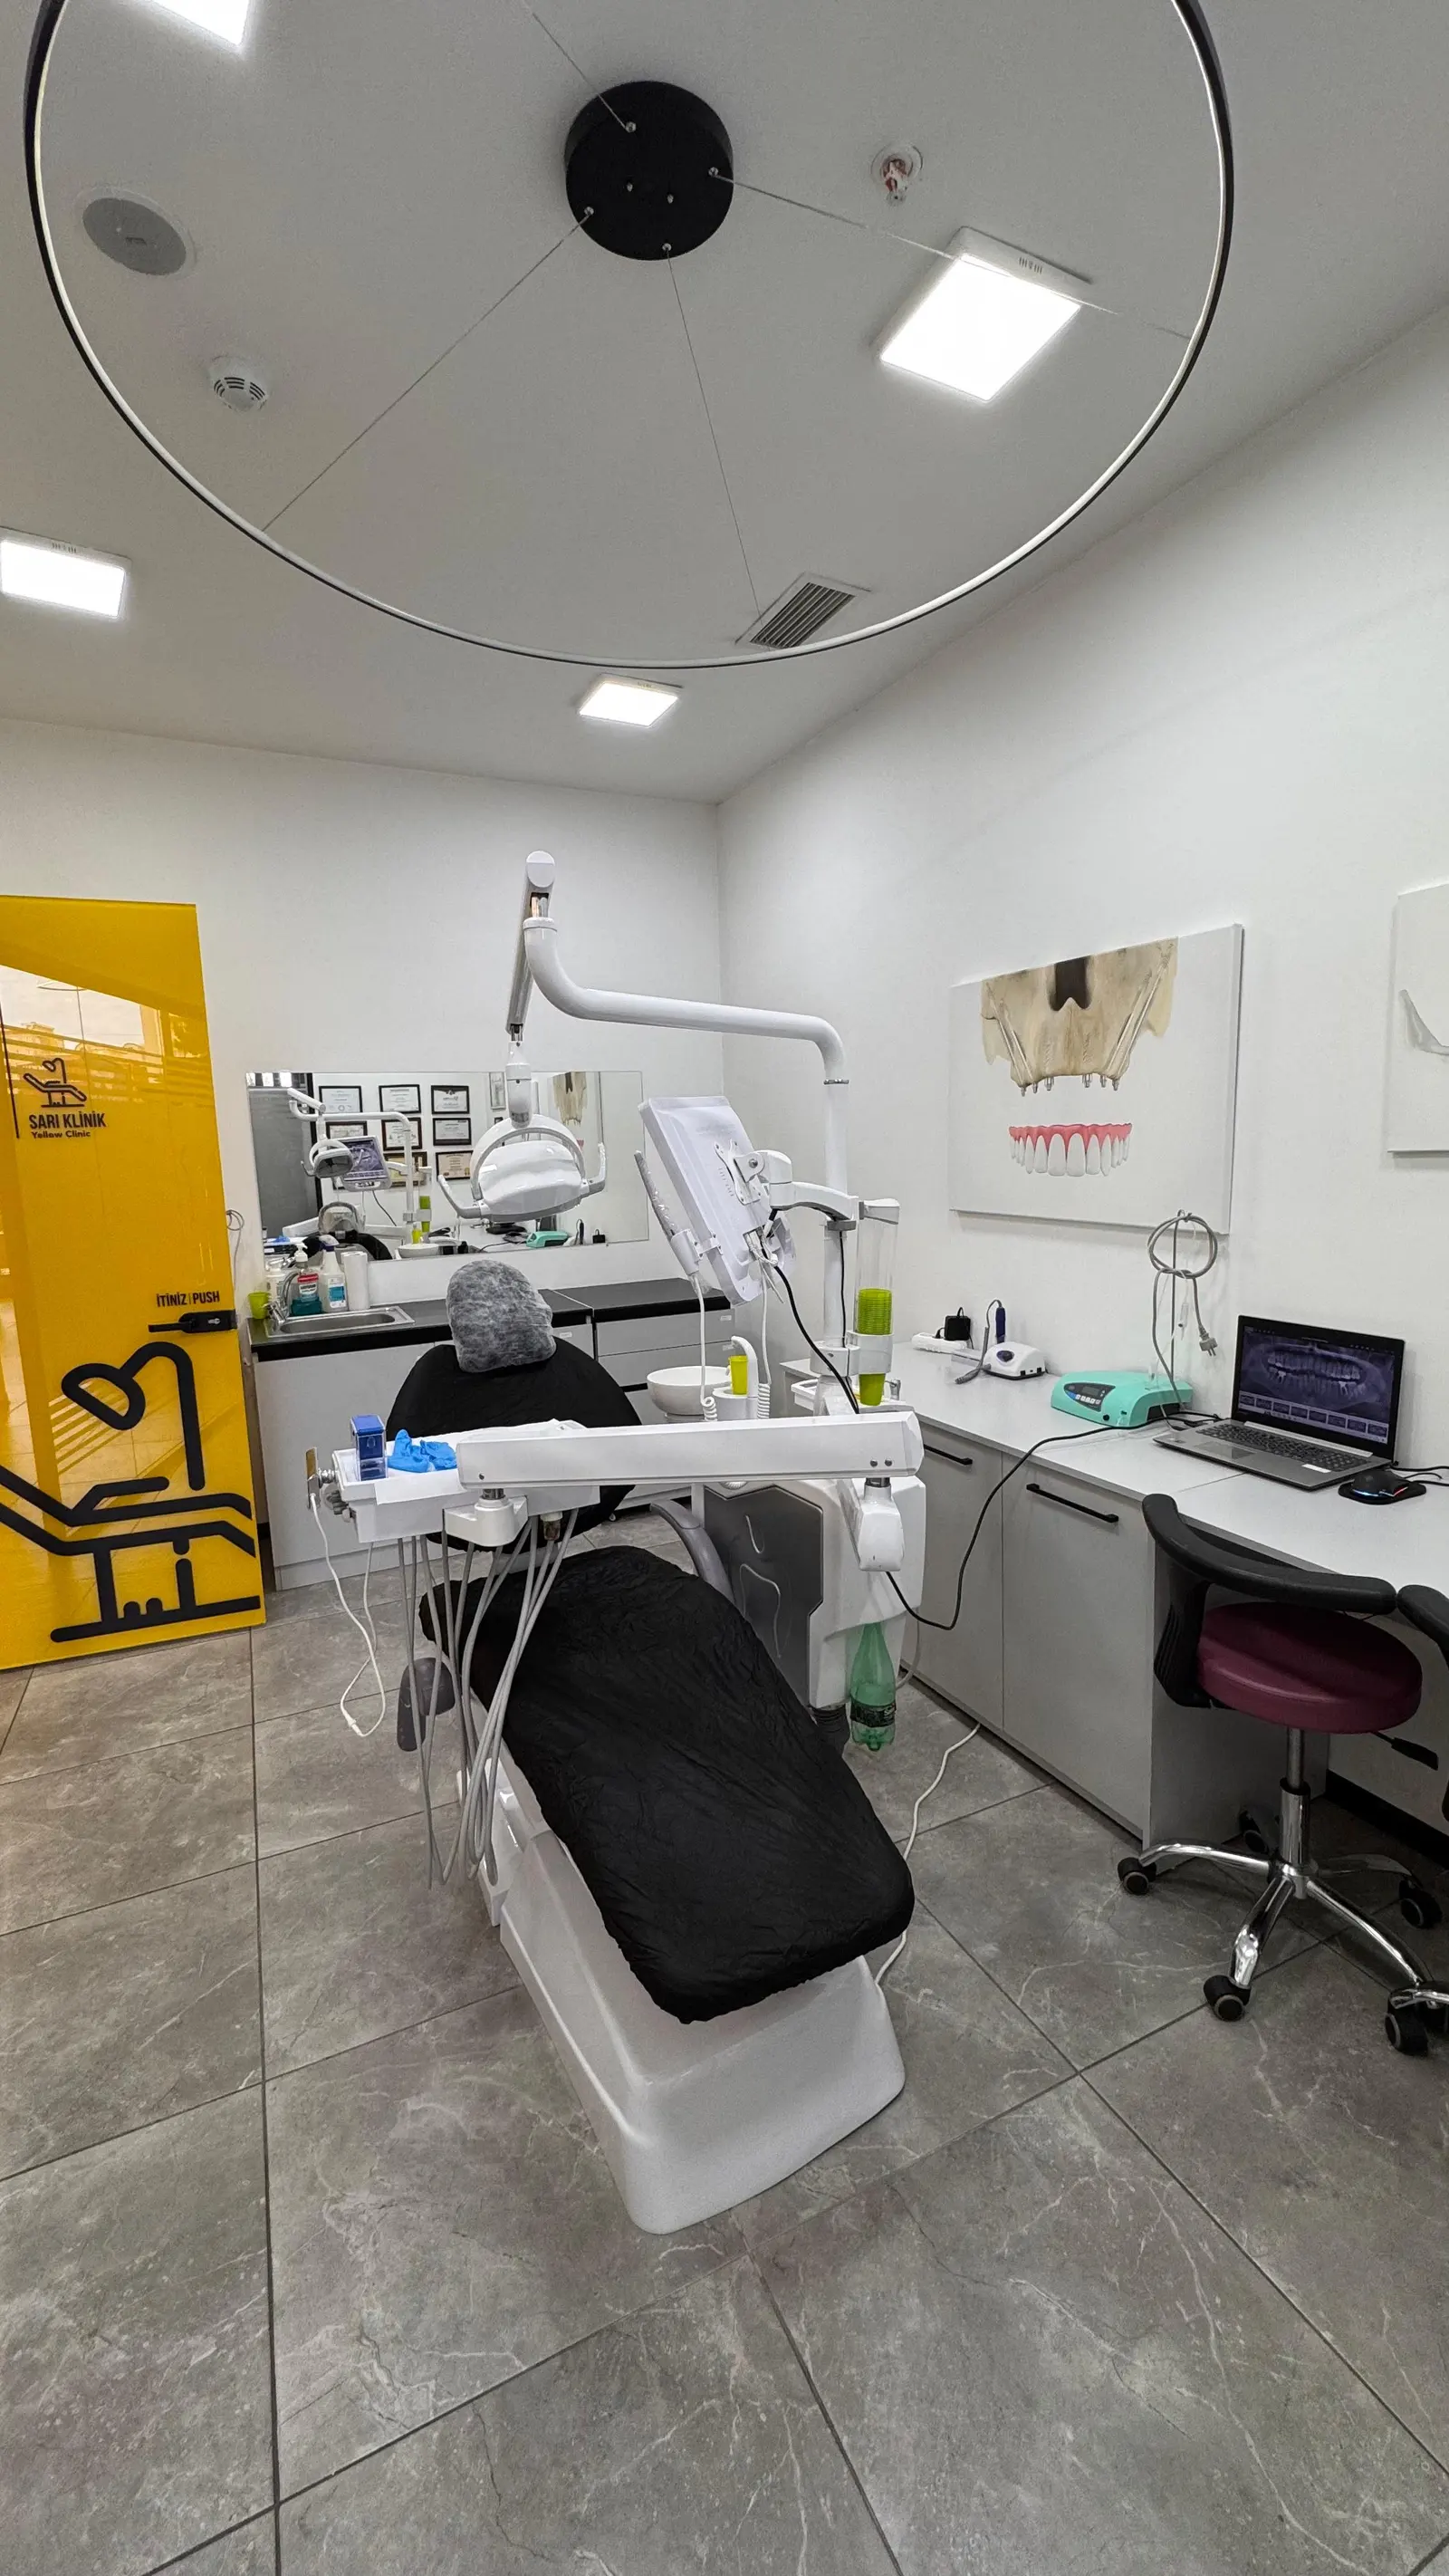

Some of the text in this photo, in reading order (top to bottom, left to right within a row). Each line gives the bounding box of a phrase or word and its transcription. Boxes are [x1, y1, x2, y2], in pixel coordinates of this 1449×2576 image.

[29, 1110, 107, 1129] SARI KLİNİK
[31, 1130, 62, 1139] Yellow
[156, 1291, 220, 1307] İTİNİZ PUSH
